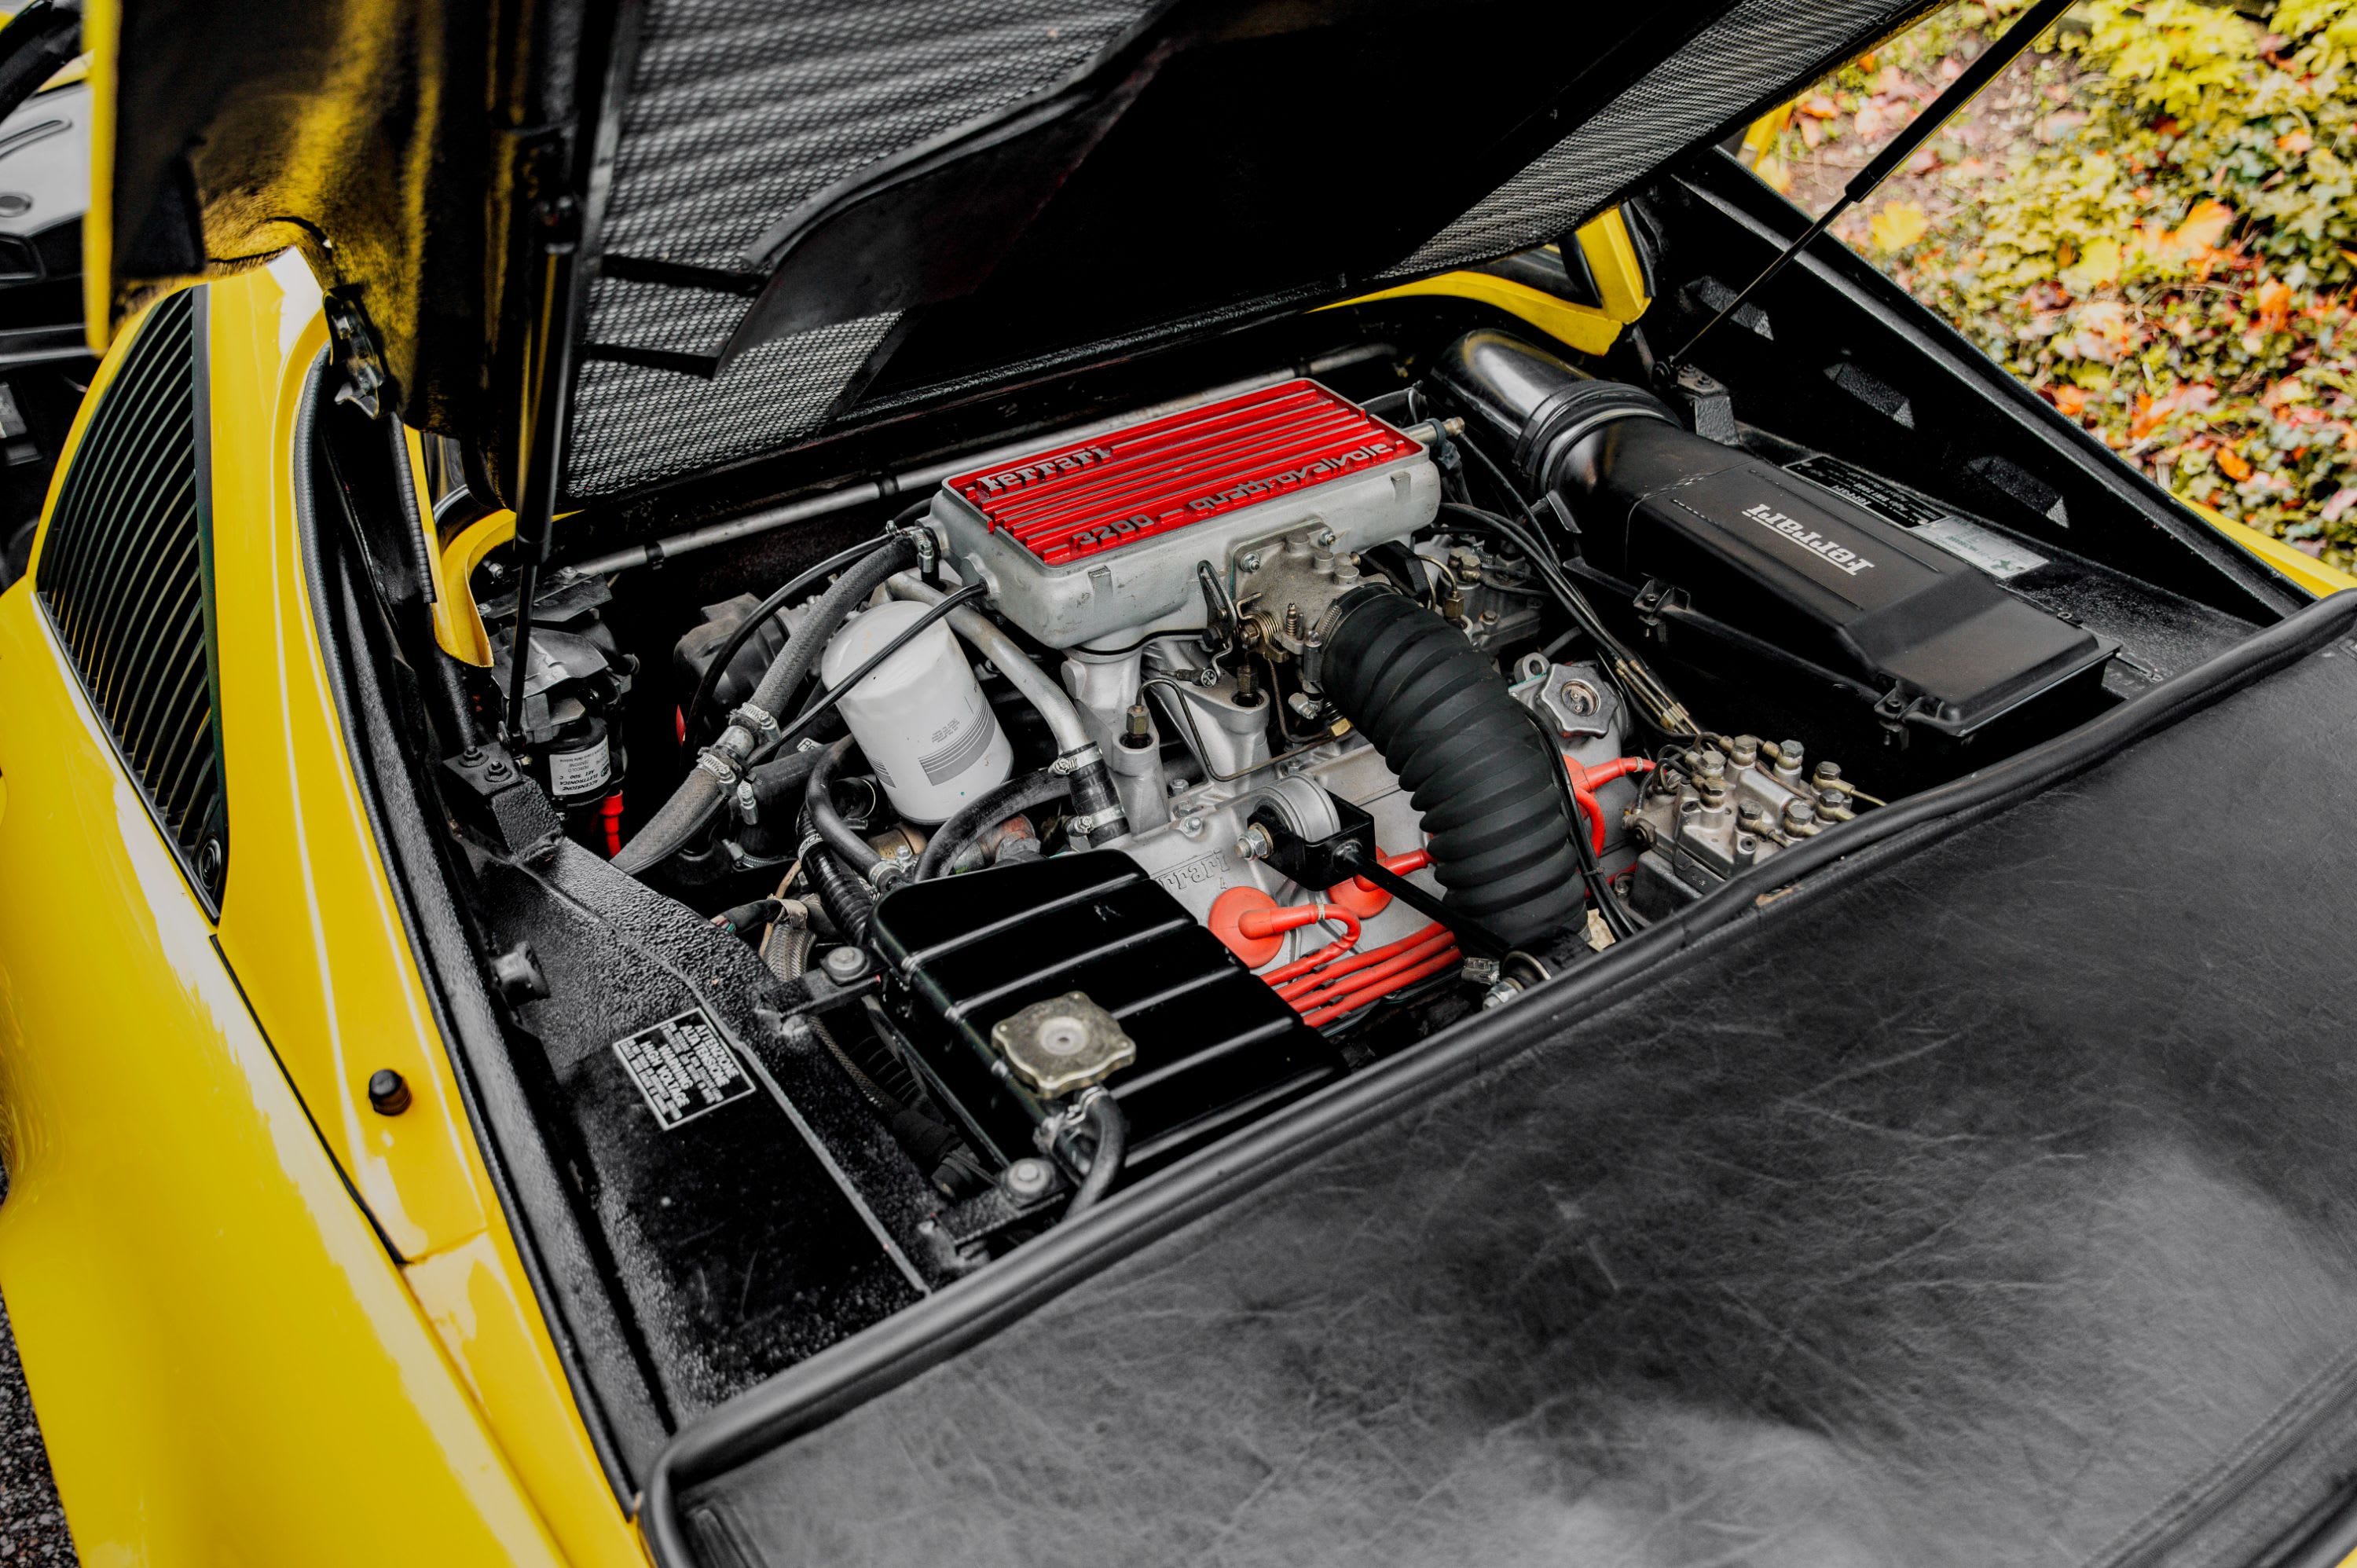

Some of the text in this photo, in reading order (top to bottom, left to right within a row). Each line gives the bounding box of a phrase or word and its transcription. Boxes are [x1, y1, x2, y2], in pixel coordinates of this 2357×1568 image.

[977, 445, 1112, 494] Ferrari
[1072, 442, 1394, 548] 3200 quattrovalvole
[1829, 485, 1872, 507] Ferrari
[1742, 504, 1875, 576] Ferrari
[559, 774, 598, 785] ELETTRONICA
[562, 780, 598, 790] ACCENSIONE
[640, 1040, 663, 1067] HIGH
[656, 1065, 691, 1108] VOLTAGE
[658, 1043, 694, 1090] WARNING
[680, 1024, 701, 1046] ALTA
[693, 1042, 731, 1088] TENSIONE
[695, 1024, 740, 1079] ATTENZIONE
